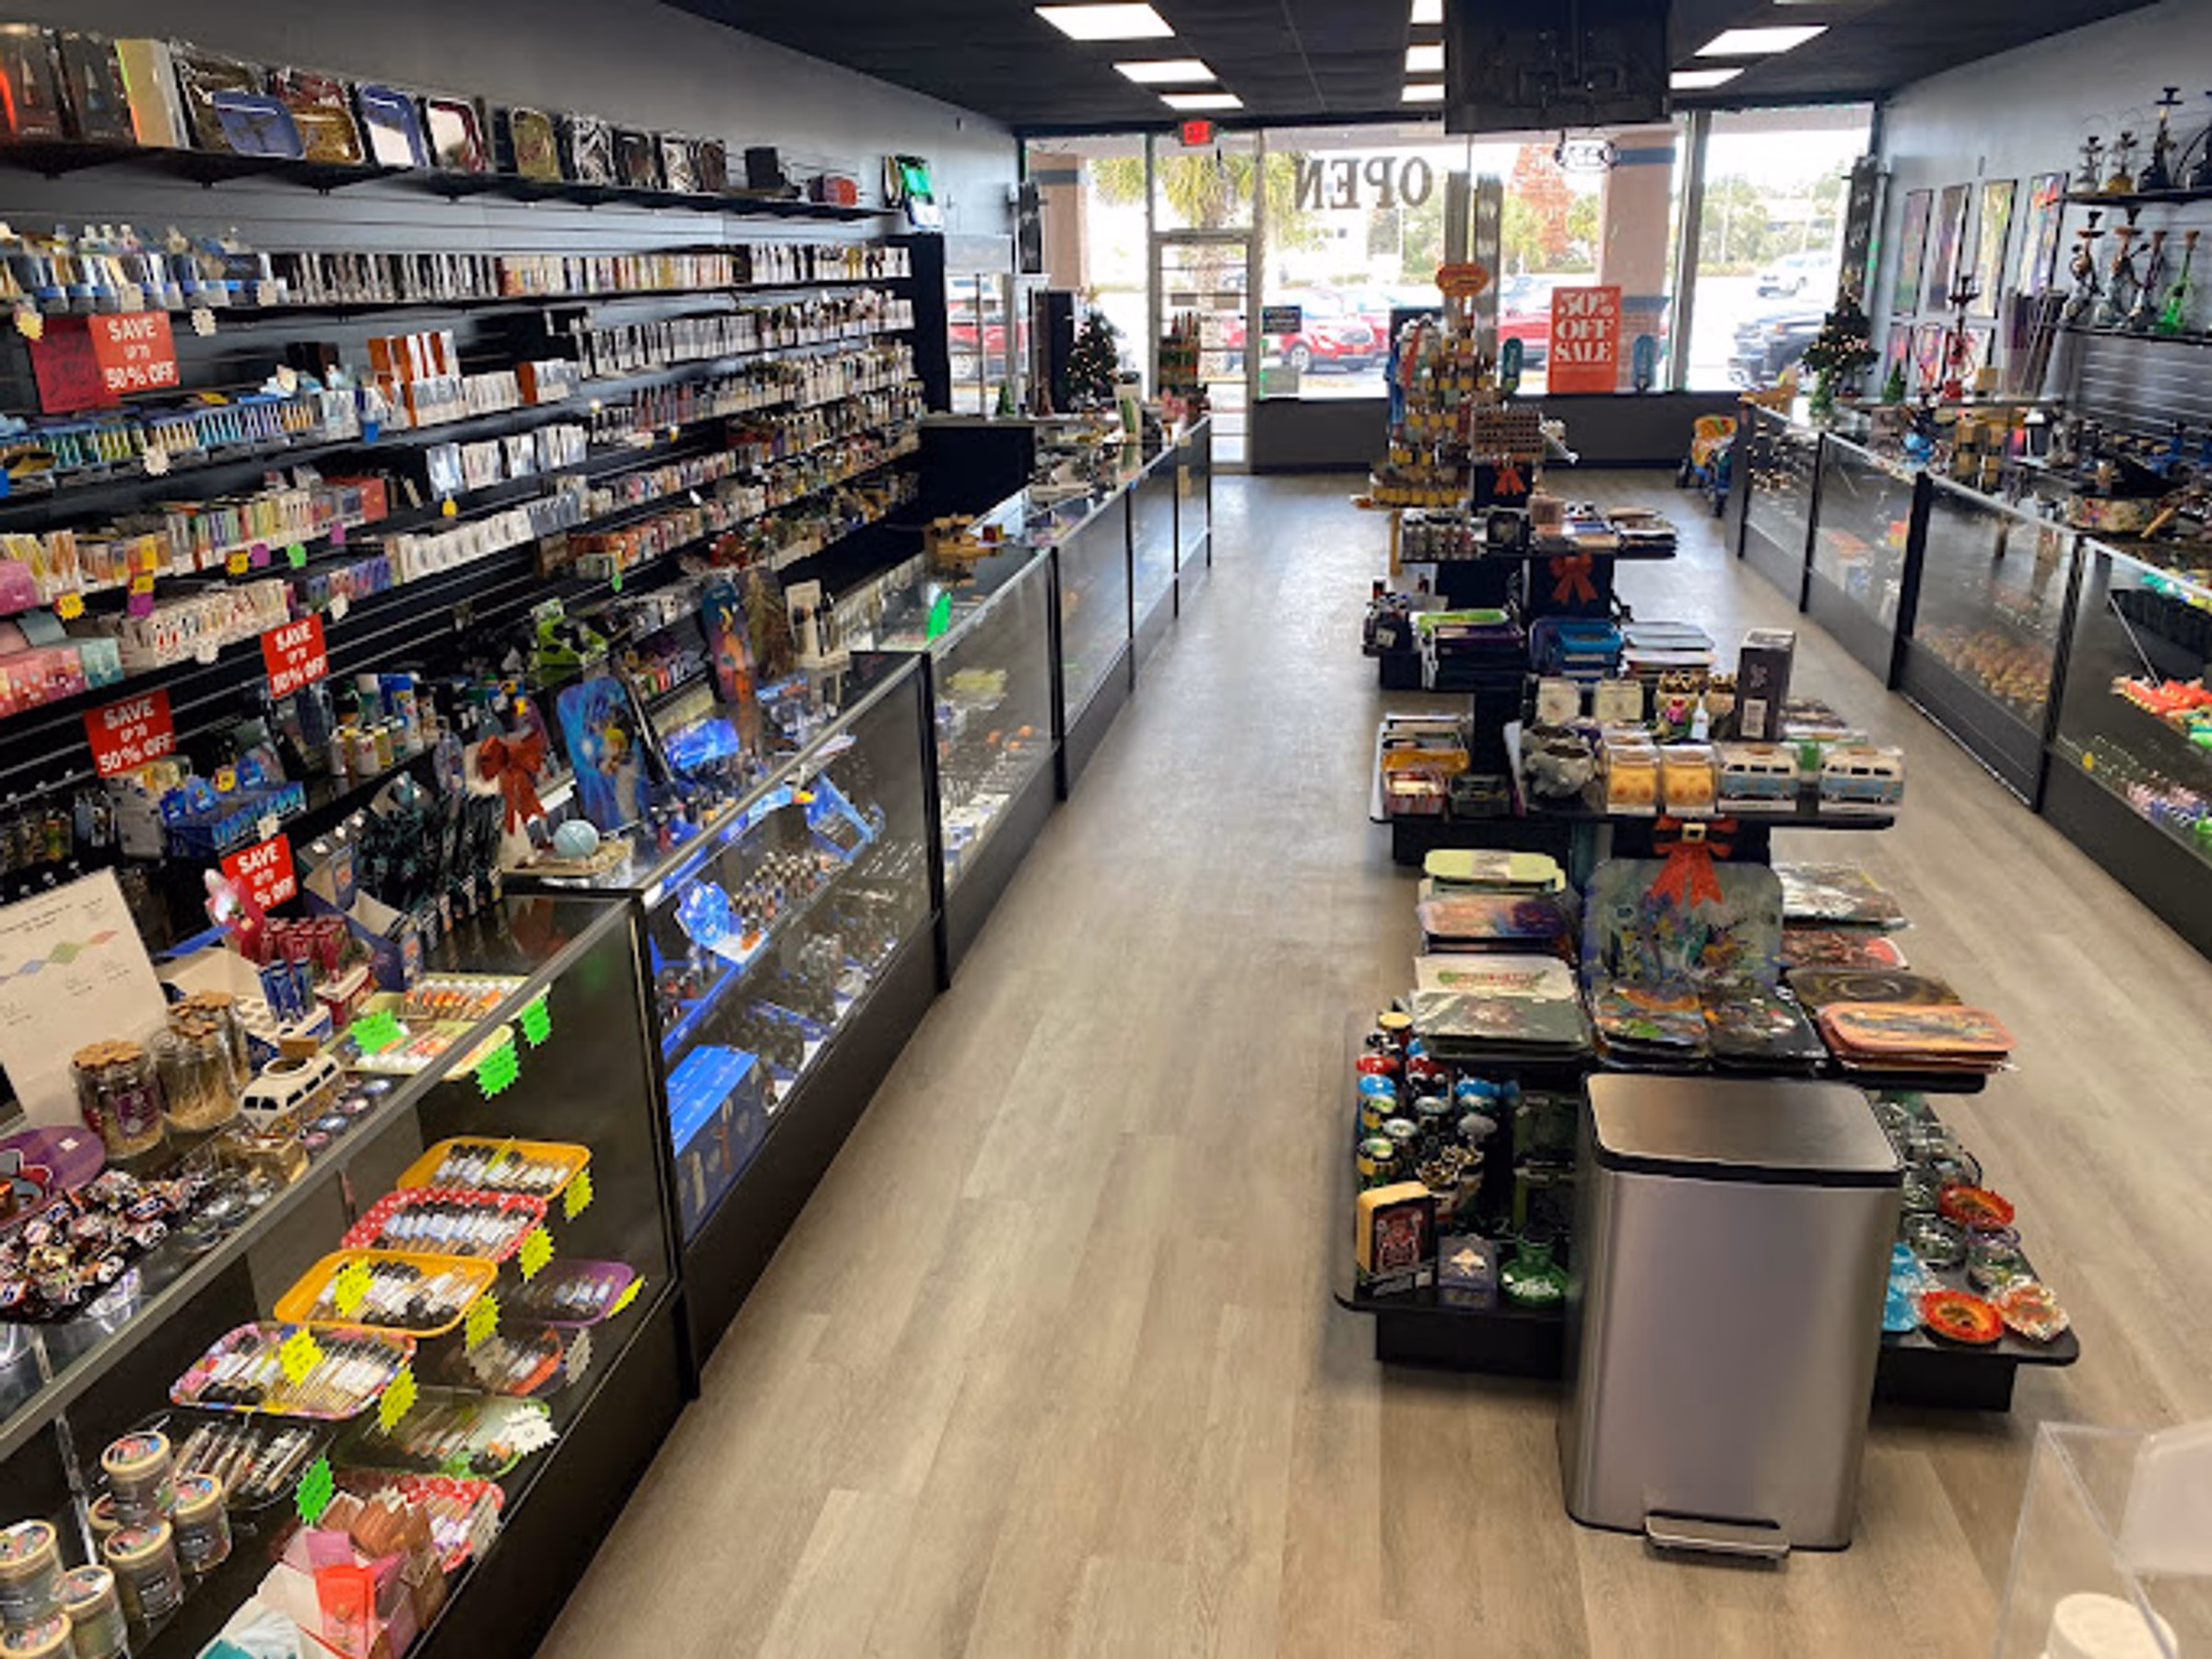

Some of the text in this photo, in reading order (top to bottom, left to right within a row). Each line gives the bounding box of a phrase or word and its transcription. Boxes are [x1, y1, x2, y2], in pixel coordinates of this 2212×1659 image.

[107, 317, 158, 342] SAVE
[1556, 319, 1614, 339] OFF
[1555, 341, 1611, 362] SALE
[148, 360, 175, 383] OFF
[275, 621, 313, 652] SAVE
[104, 698, 155, 730] SAVE
[98, 732, 172, 772] 50% OFF
[238, 842, 280, 875] SAVE
[271, 875, 294, 902] OFF
